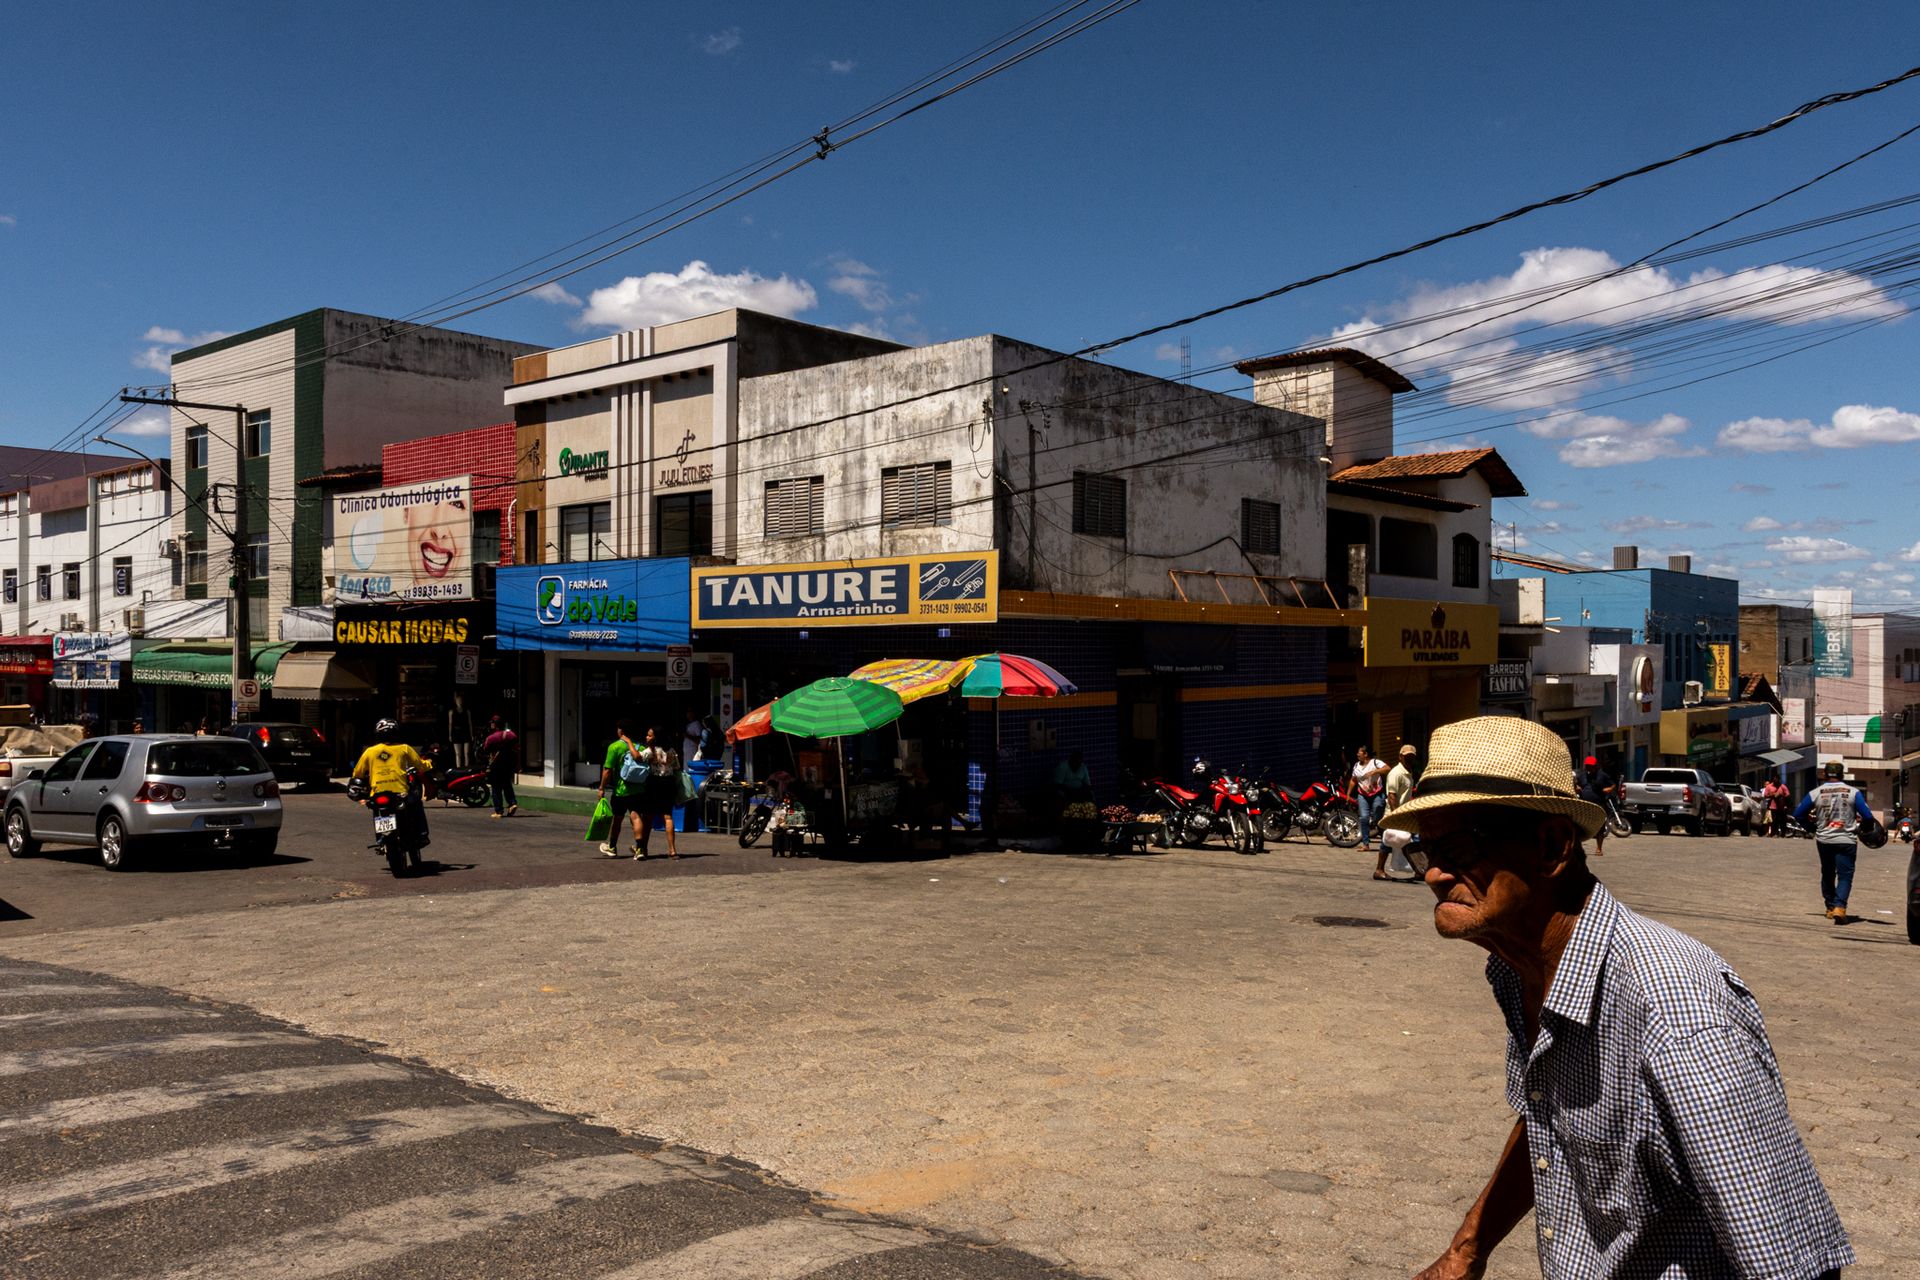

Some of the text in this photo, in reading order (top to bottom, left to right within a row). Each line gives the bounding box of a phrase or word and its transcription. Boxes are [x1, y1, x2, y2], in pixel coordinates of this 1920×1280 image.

[658, 463, 713, 485] JUJU FITNESS
[404, 589, 411, 598] 33
[412, 583, 463, 598] 99936-1493
[568, 577, 608, 591] FARMÁCIA
[705, 568, 897, 606] TANURE
[567, 594, 638, 623] do Vale
[797, 602, 897, 617] Armarinho
[919, 603, 950, 615] 3731-1429
[954, 602, 988, 614] 99902-0541
[336, 617, 469, 645] CAUSAR MODAS
[464, 659, 471, 668] E
[1413, 651, 1459, 662] UTILIDADES
[676, 661, 683, 672] E
[1489, 664, 1524, 675] BARROSO
[245, 684, 253, 694] E
[1489, 676, 1525, 692] FASHION
[503, 688, 516, 699] 192
